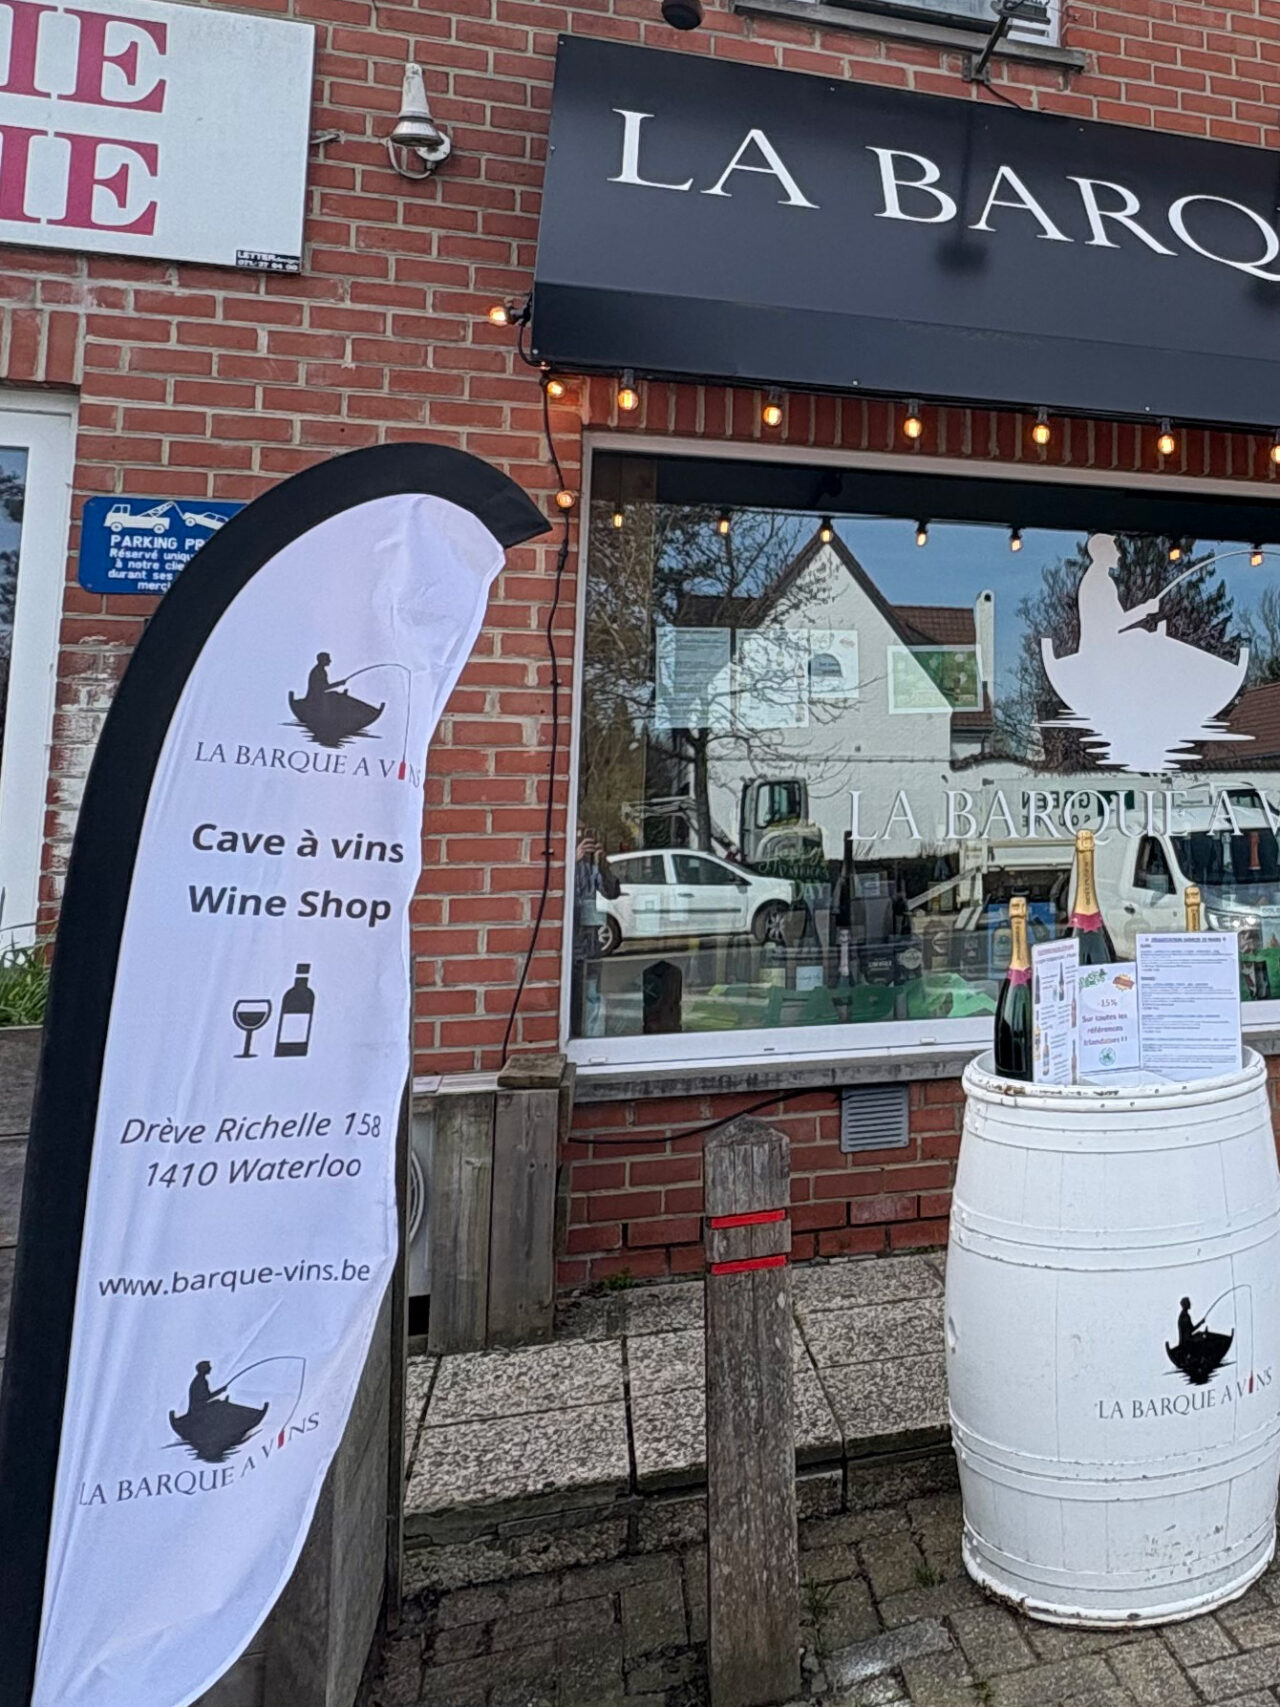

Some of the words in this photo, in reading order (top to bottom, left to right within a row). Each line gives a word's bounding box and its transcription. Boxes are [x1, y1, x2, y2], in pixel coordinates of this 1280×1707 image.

[607, 108, 821, 209] LA
[109, 548, 158, 560] Réservé
[110, 535, 178, 550] PARKING
[108, 570, 147, 580] durant
[153, 572, 173, 581] ses
[115, 559, 122, 568] à
[128, 561, 159, 570] notre
[165, 561, 185, 571] clie
[195, 742, 226, 763] LA
[235, 744, 347, 773] BARQUE
[352, 757, 370, 776] A
[847, 790, 922, 841] LA
[945, 789, 1190, 845] BARQUE
[1206, 789, 1244, 836] A
[191, 823, 285, 857] Cave
[296, 828, 318, 858] à
[331, 831, 405, 863] vins
[188, 884, 287, 917] Wine
[297, 889, 392, 927] Shop
[120, 1116, 206, 1145] Drève
[215, 1112, 331, 1144] Richelle
[344, 1112, 381, 1138] 158
[146, 1161, 217, 1189] 1410
[228, 1152, 361, 1184] Waterloo
[99, 1259, 371, 1297] www.barque-vins.be
[1099, 1400, 1123, 1419] LA
[1132, 1389, 1216, 1419] BARQUE
[1220, 1385, 1232, 1404] A
[79, 1482, 107, 1505] LA
[116, 1466, 235, 1502] BARQUE
[240, 1456, 256, 1478] A
